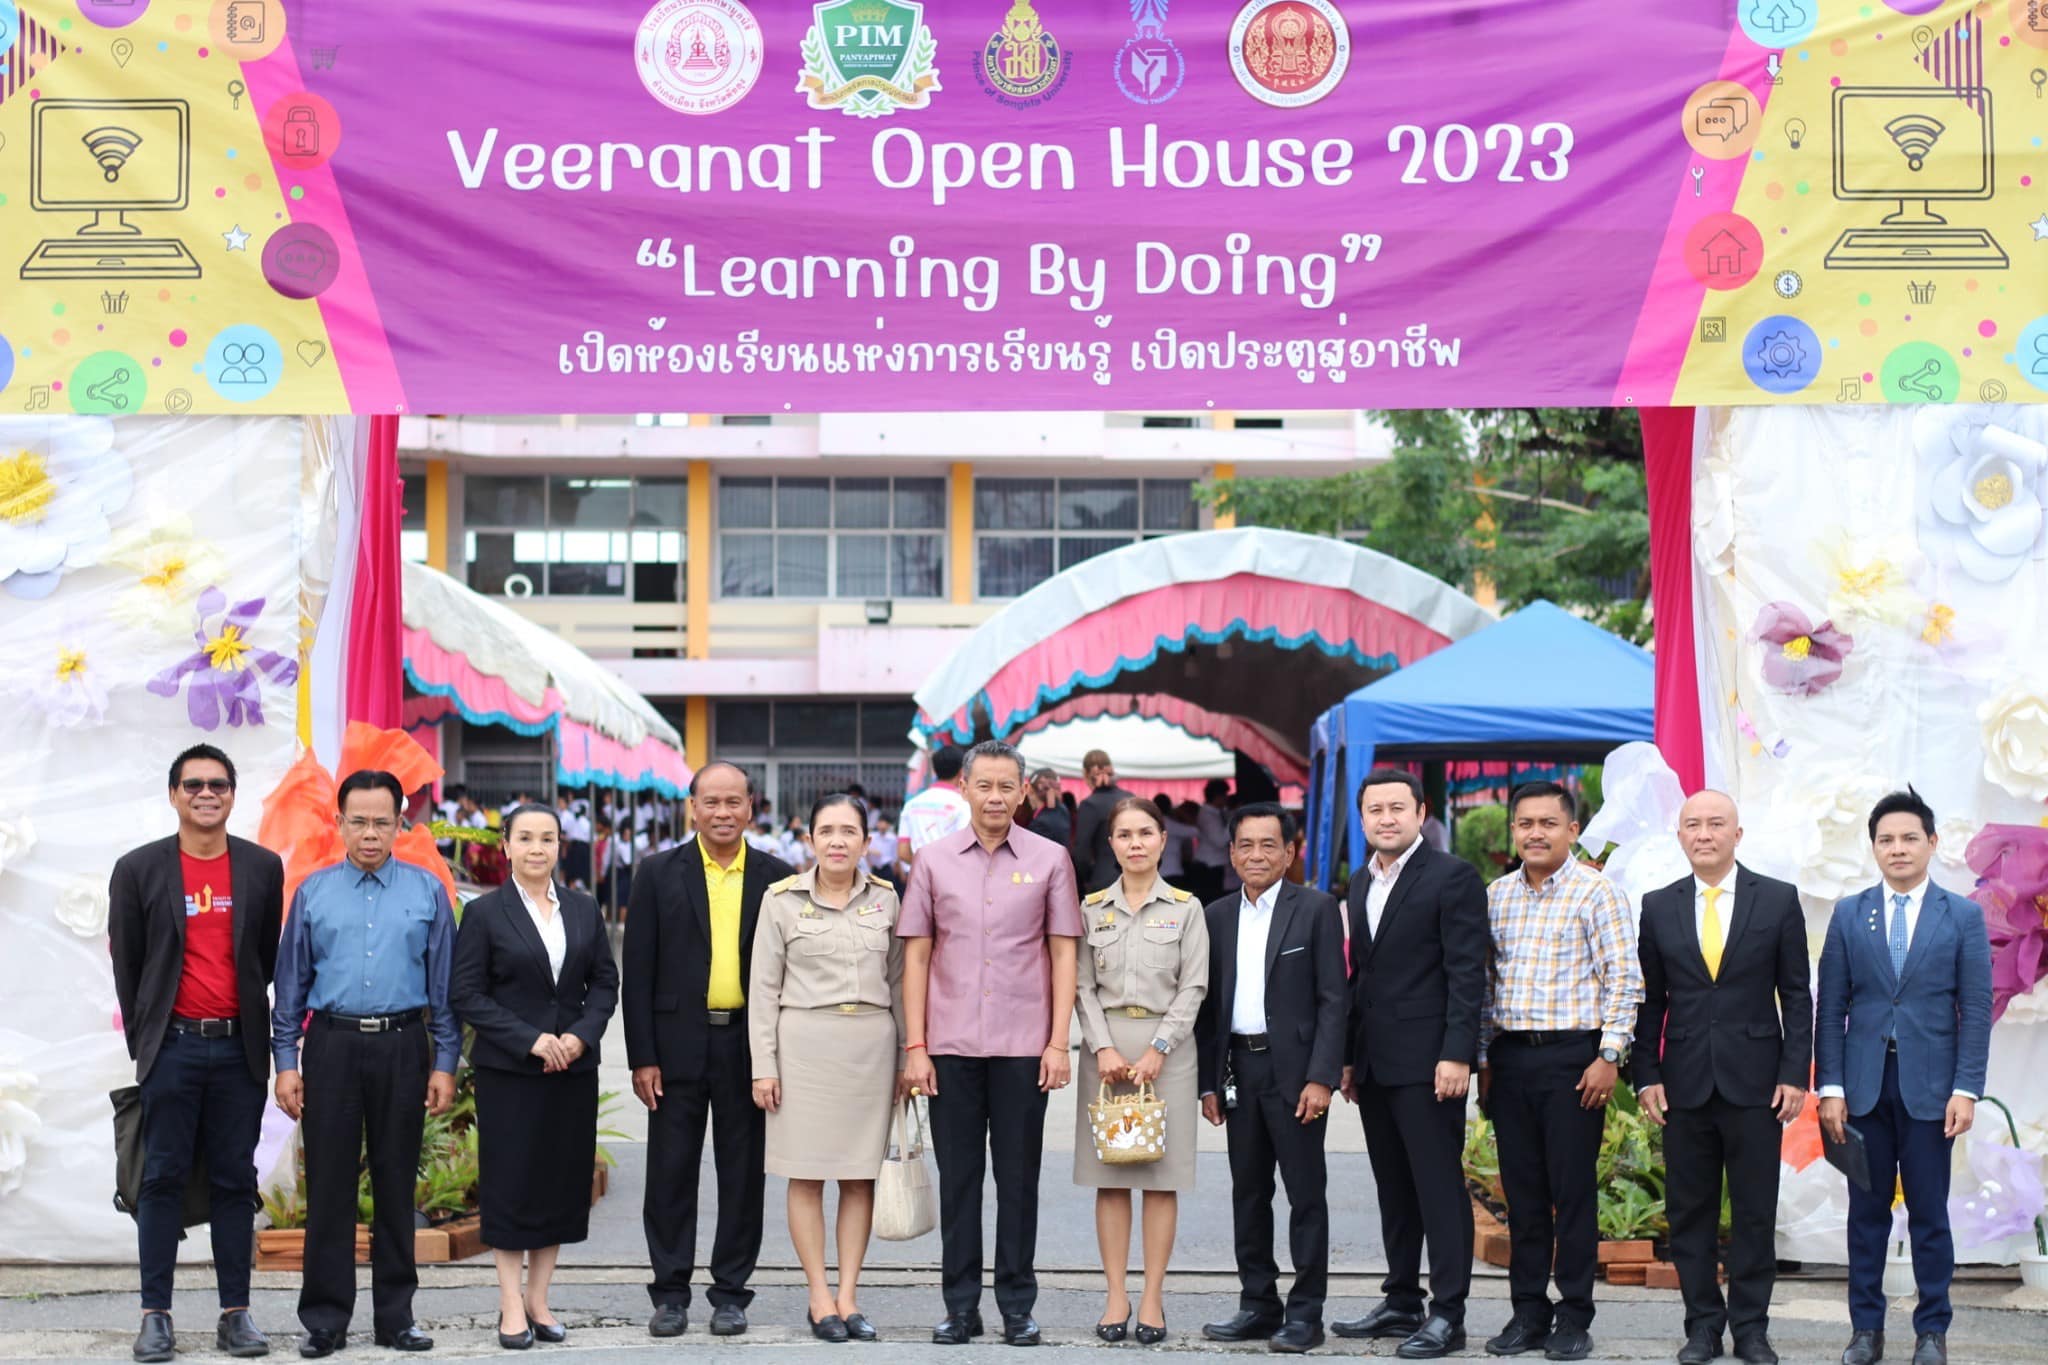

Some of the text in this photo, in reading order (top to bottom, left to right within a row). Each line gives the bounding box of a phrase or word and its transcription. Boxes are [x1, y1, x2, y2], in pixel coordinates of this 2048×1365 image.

[834, 24, 905, 47] PIM
[839, 53, 898, 61] PANYAPIWAT
[446, 121, 1575, 206] Veeranat Open House 2023
[636, 232, 1383, 312] “Learning By Doing”
[558, 312, 1462, 386] เปิดห้องเรียนแห่งการเรียนรู้ เปิดประตูสู่อาชีพ
